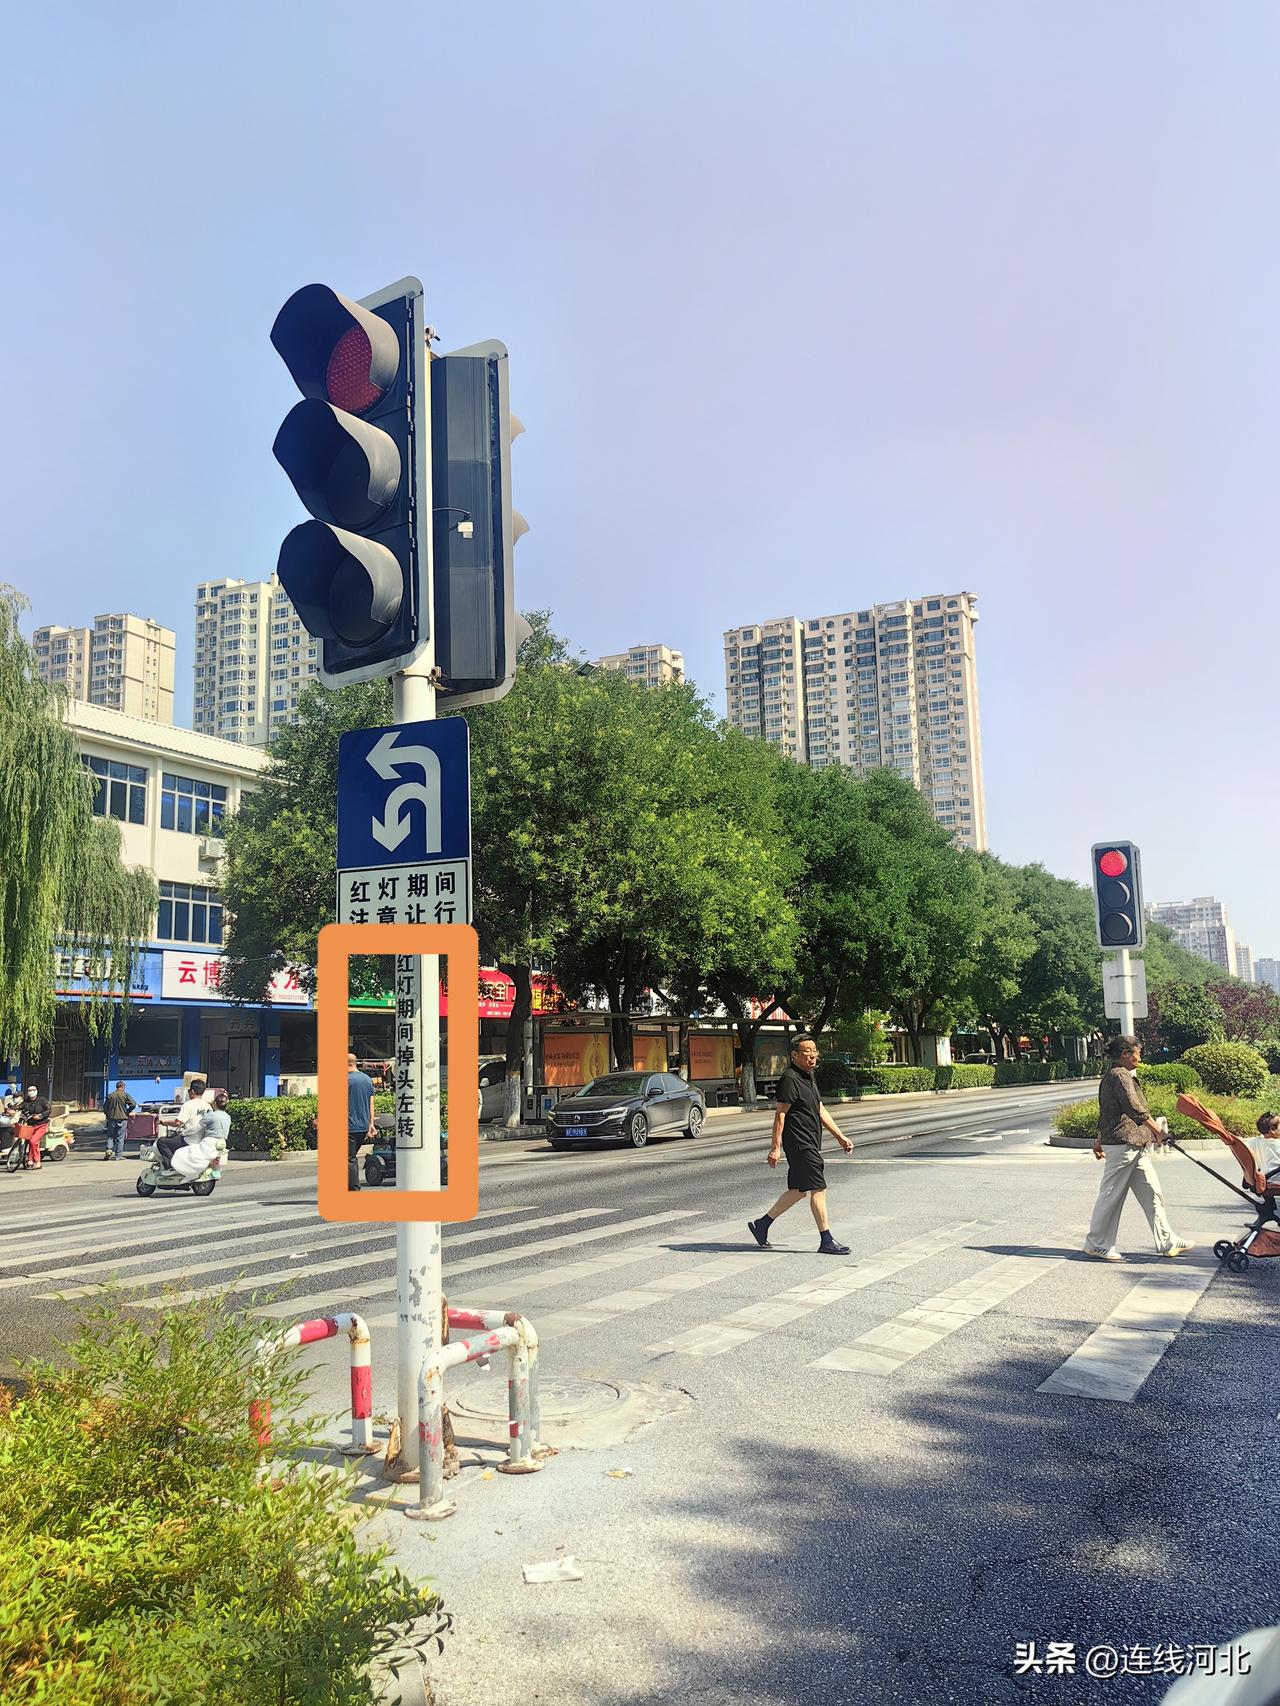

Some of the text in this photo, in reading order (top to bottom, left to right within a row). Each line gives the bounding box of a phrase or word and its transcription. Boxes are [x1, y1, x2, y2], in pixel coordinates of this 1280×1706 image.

[350, 871, 456, 903] 红灯期间
[397, 955, 415, 1138] 红灯期间掉头左转
